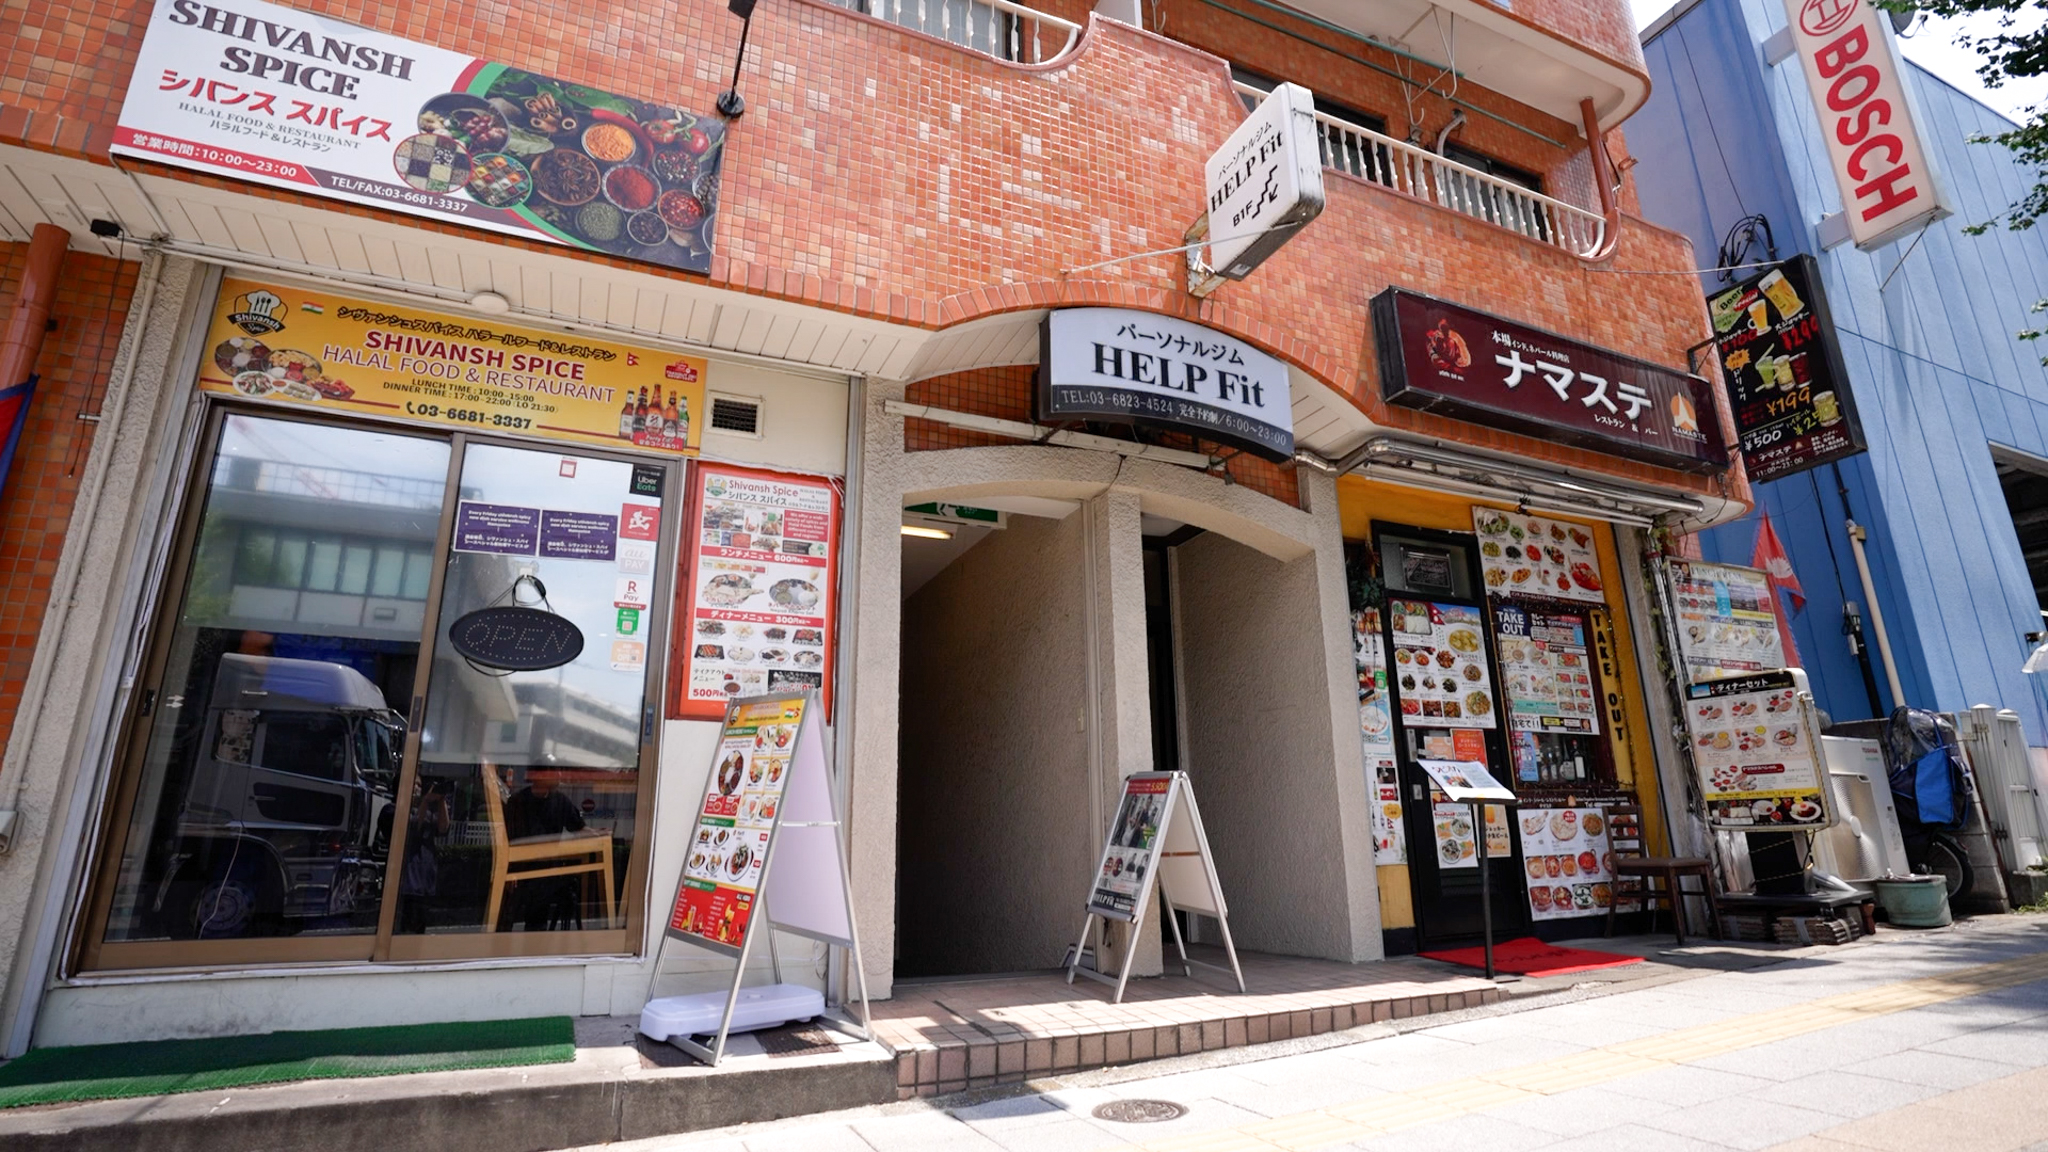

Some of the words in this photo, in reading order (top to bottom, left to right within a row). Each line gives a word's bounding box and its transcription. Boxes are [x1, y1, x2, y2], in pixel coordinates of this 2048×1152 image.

[169, 0, 415, 81] SHIVANSH
[220, 46, 360, 100] SPICE
[159, 69, 276, 115] シバンス
[286, 100, 392, 142] スパイス
[179, 102, 224, 119] HALAL
[227, 112, 264, 128] FOOD
[265, 122, 275, 131] &
[278, 125, 361, 149] RESTAURANT
[1814, 23, 1918, 222] BOSCH
[1218, 121, 1272, 179] パーソナルジム
[1211, 157, 1257, 214] HELP
[1259, 131, 1284, 166] Fit
[331, 175, 468, 213] TEL/FAX:03-6681-3337
[1232, 201, 1253, 227] B1F
[1720, 288, 1743, 311] Beer
[235, 313, 280, 330] Shivansh
[337, 306, 464, 338] シヴァンシュスパイス
[365, 330, 504, 368] SHIVANSH
[512, 354, 586, 382] SPICE
[1117, 323, 1244, 366] パーソナルジム
[323, 344, 393, 372] HALAL
[400, 356, 460, 382] FOOD
[465, 367, 481, 384] &
[486, 370, 617, 404] RESTAURANT
[1091, 341, 1207, 394] HELP
[1215, 369, 1265, 408] Fit
[1495, 350, 1653, 420] ナマステ
[383, 382, 421, 395] DINNER
[423, 386, 447, 399] TIME
[412, 378, 446, 391] LUNCH
[448, 382, 472, 394] TIME
[1061, 389, 1173, 413] TEL:03-6823-4524
[417, 401, 532, 430] 03-6681-3337
[1594, 414, 1626, 429] レストラン
[1672, 426, 1708, 441] NAMASTE
[1744, 430, 1782, 451] ¥500
[636, 483, 656, 492] Eats
[637, 475, 657, 485] Uber
[728, 479, 770, 494] Shivansh
[773, 486, 798, 498] Spice
[729, 491, 757, 502] シバンス
[760, 495, 787, 506] スパイス
[625, 560, 644, 569] PAY
[721, 549, 772, 561] ランチメニュー
[624, 593, 639, 602] Pay
[628, 580, 637, 592] R
[711, 610, 771, 622] ディナーメニュー
[1496, 610, 1525, 625] TAKE
[465, 621, 572, 654] OPEN
[1502, 623, 1525, 635] OUT
[1593, 613, 1612, 676] TAKE
[1607, 692, 1623, 742] OUT
[1716, 678, 1768, 692] ディナーセット
